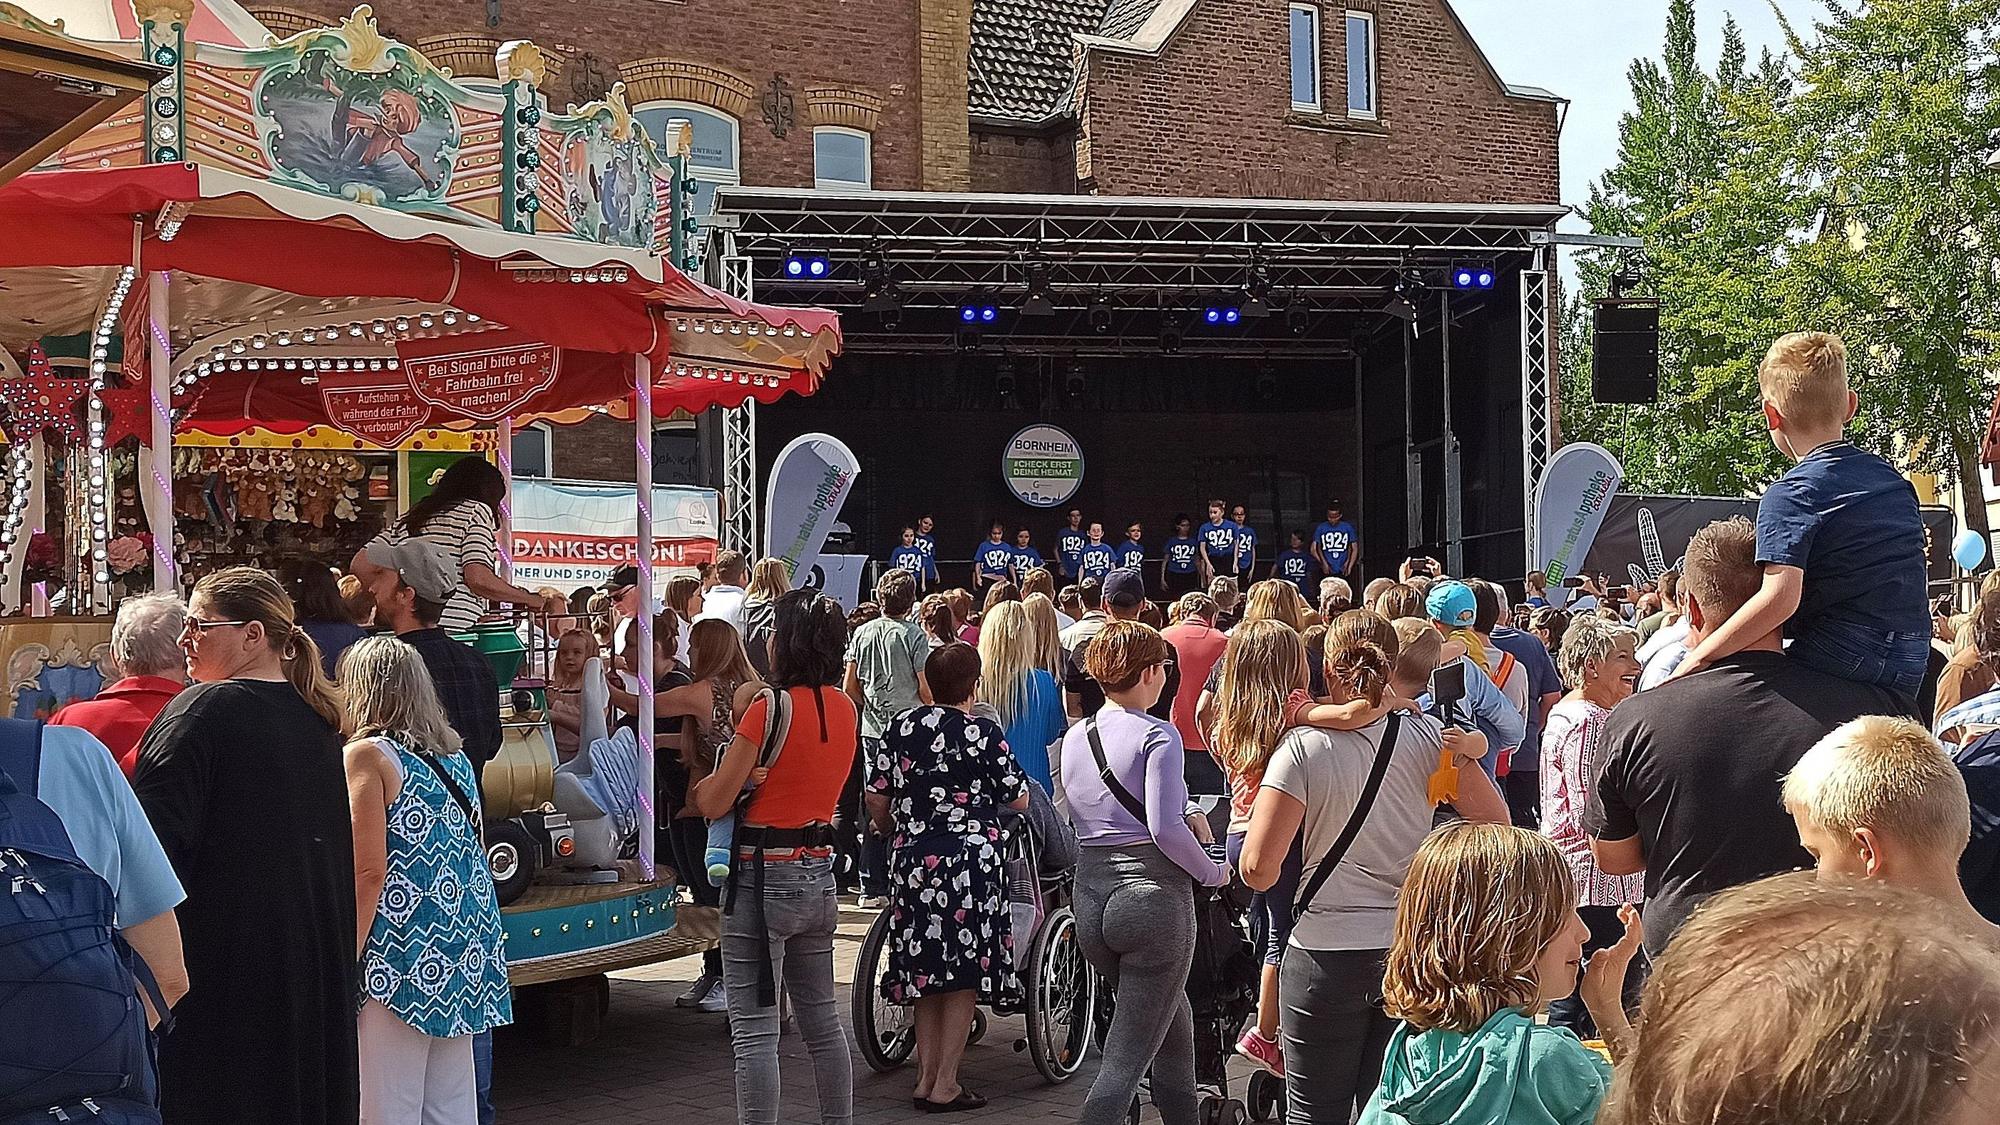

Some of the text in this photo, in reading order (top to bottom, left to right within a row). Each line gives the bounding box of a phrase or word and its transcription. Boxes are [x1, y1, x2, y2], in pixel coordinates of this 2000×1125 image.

[428, 352, 537, 377] Bei Signal bitte die
[446, 369, 524, 392] Fahrbahn frei
[358, 392, 400, 404] Aufstehen
[461, 388, 511, 407] machen!
[342, 405, 418, 420] während der Fahrt
[363, 420, 402, 433] verboten!
[1014, 440, 1074, 453] BORNHEIM
[1013, 468, 1073, 477] DEINE HEIMAT
[1050, 461, 1073, 469] ERST
[914, 538, 934, 556] 24
[1321, 532, 1349, 551] 1924
[1013, 555, 1035, 570] 24
[1083, 551, 1109, 569] 1924
[1123, 550, 1144, 568] 192
[1285, 558, 1306, 575] 192
[514, 567, 540, 578] NER
[544, 568, 573, 579] UND
